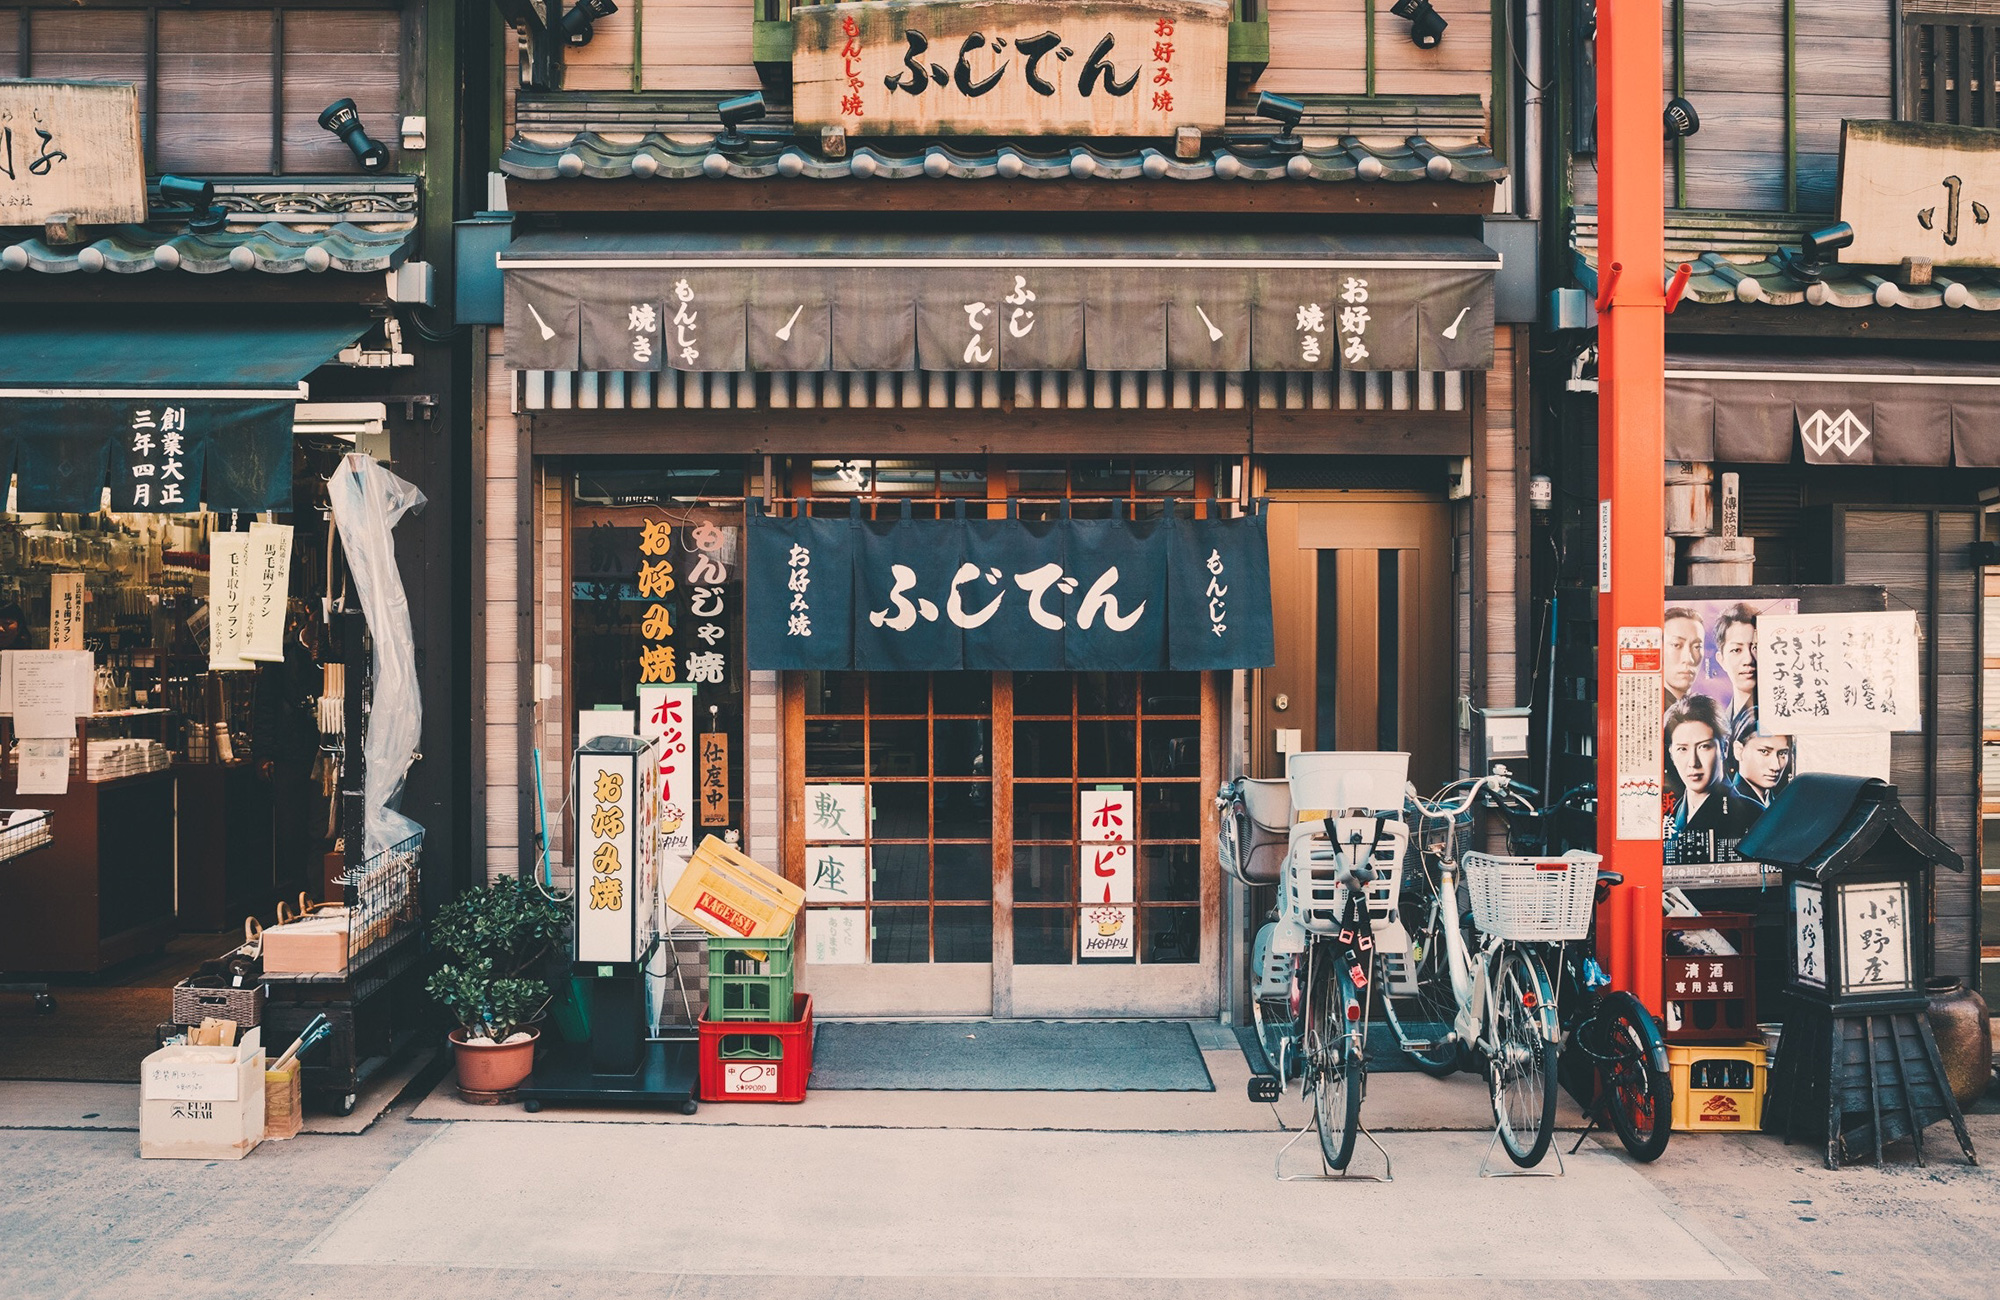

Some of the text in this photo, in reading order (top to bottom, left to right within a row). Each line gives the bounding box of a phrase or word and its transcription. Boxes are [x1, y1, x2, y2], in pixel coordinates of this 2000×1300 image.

[841, 15, 864, 117] もんじゃ焼
[884, 28, 1142, 98] ふじでん
[1151, 17, 1175, 113] お好み焼
[1918, 175, 1989, 246] 小
[628, 303, 657, 363] 焼き
[674, 278, 700, 365] もんじゃ
[963, 302, 993, 363] でん
[1005, 275, 1036, 338] ふじ
[1296, 303, 1326, 362] 焼き
[1340, 276, 1371, 363] お好み
[132, 409, 156, 507] 三年四月
[159, 406, 186, 505] 創業大正
[227, 552, 240, 640] 毛玉取りブラシ
[261, 543, 276, 618] 馬毛歯ブラシ
[638, 518, 676, 684] お好み焼
[685, 520, 727, 684] もんじゃ焼
[787, 542, 812, 637] お好み焼
[870, 562, 1147, 632] ふじでん
[1206, 548, 1228, 638] もんじゃ
[651, 693, 687, 802] ホッピー
[703, 740, 725, 811] 仕度中
[589, 768, 624, 912] お好み焼
[662, 835, 688, 850] ppy
[813, 790, 850, 836] 敷
[812, 855, 848, 895] 座
[1092, 797, 1127, 904] ホッピー
[700, 894, 752, 931] KAGETSU
[1086, 937, 1128, 949] Hoppy
[1802, 898, 1817, 976] 小野屋
[1859, 900, 1890, 984] 小野屋
[1675, 981, 1734, 994] 専用通箱
[1684, 962, 1724, 979] 清酒
[188, 1102, 212, 1111] FUJI
[766, 1067, 775, 1076] 20
[187, 1111, 212, 1119] STAR
